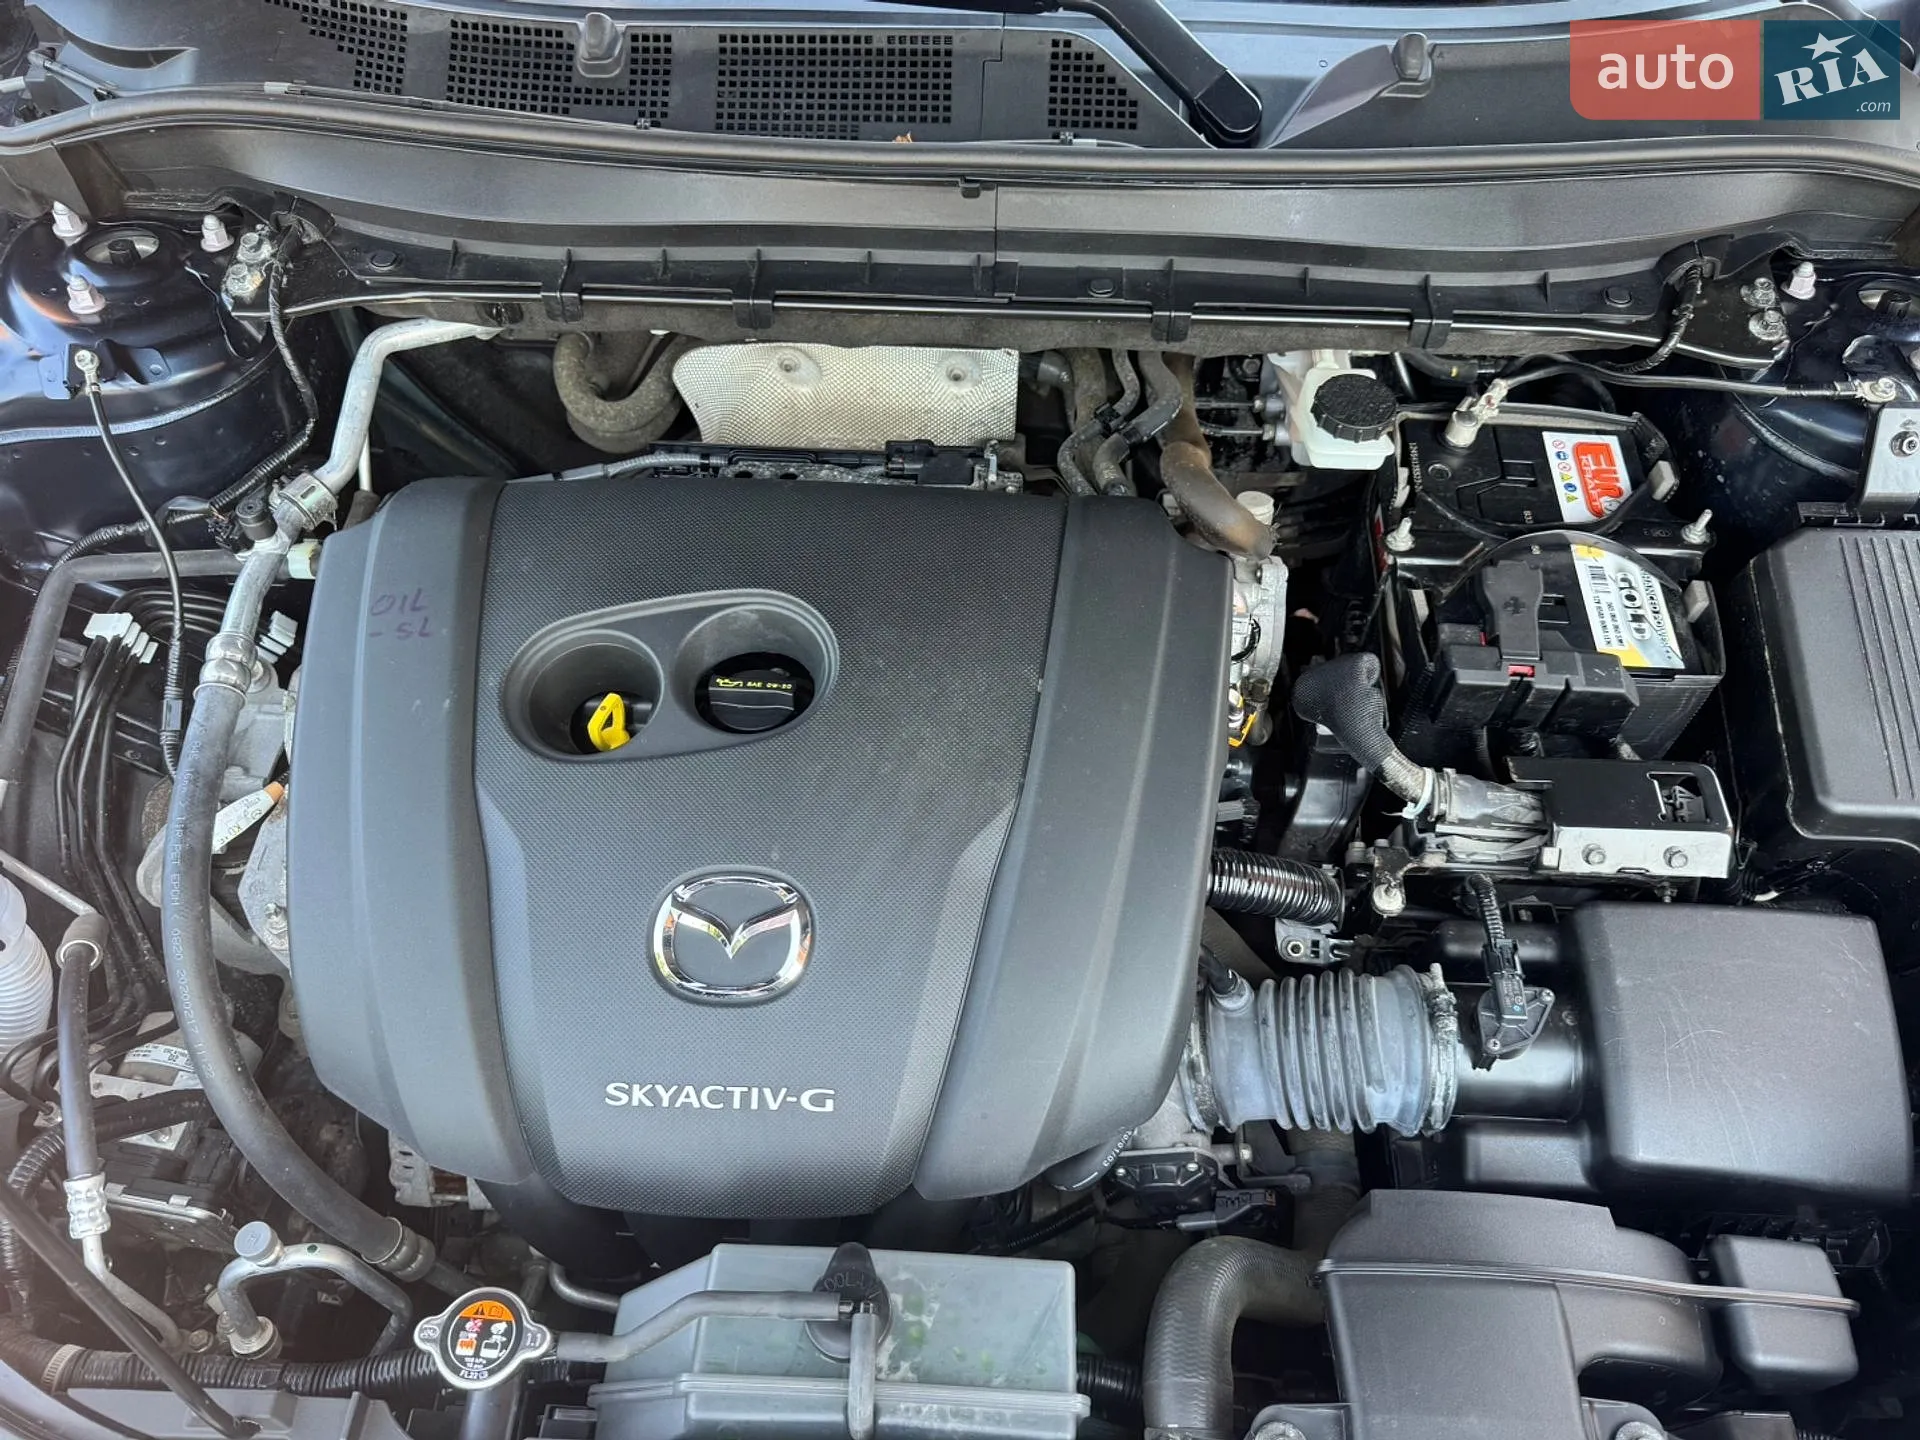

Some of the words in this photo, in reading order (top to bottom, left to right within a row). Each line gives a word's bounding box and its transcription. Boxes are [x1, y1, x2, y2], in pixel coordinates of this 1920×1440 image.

[369, 587, 429, 617] OIL
[1615, 571, 1653, 641] GOLD
[604, 1081, 836, 1113] SKYACTIV-G
[526, 1332, 542, 1347] 1.1
